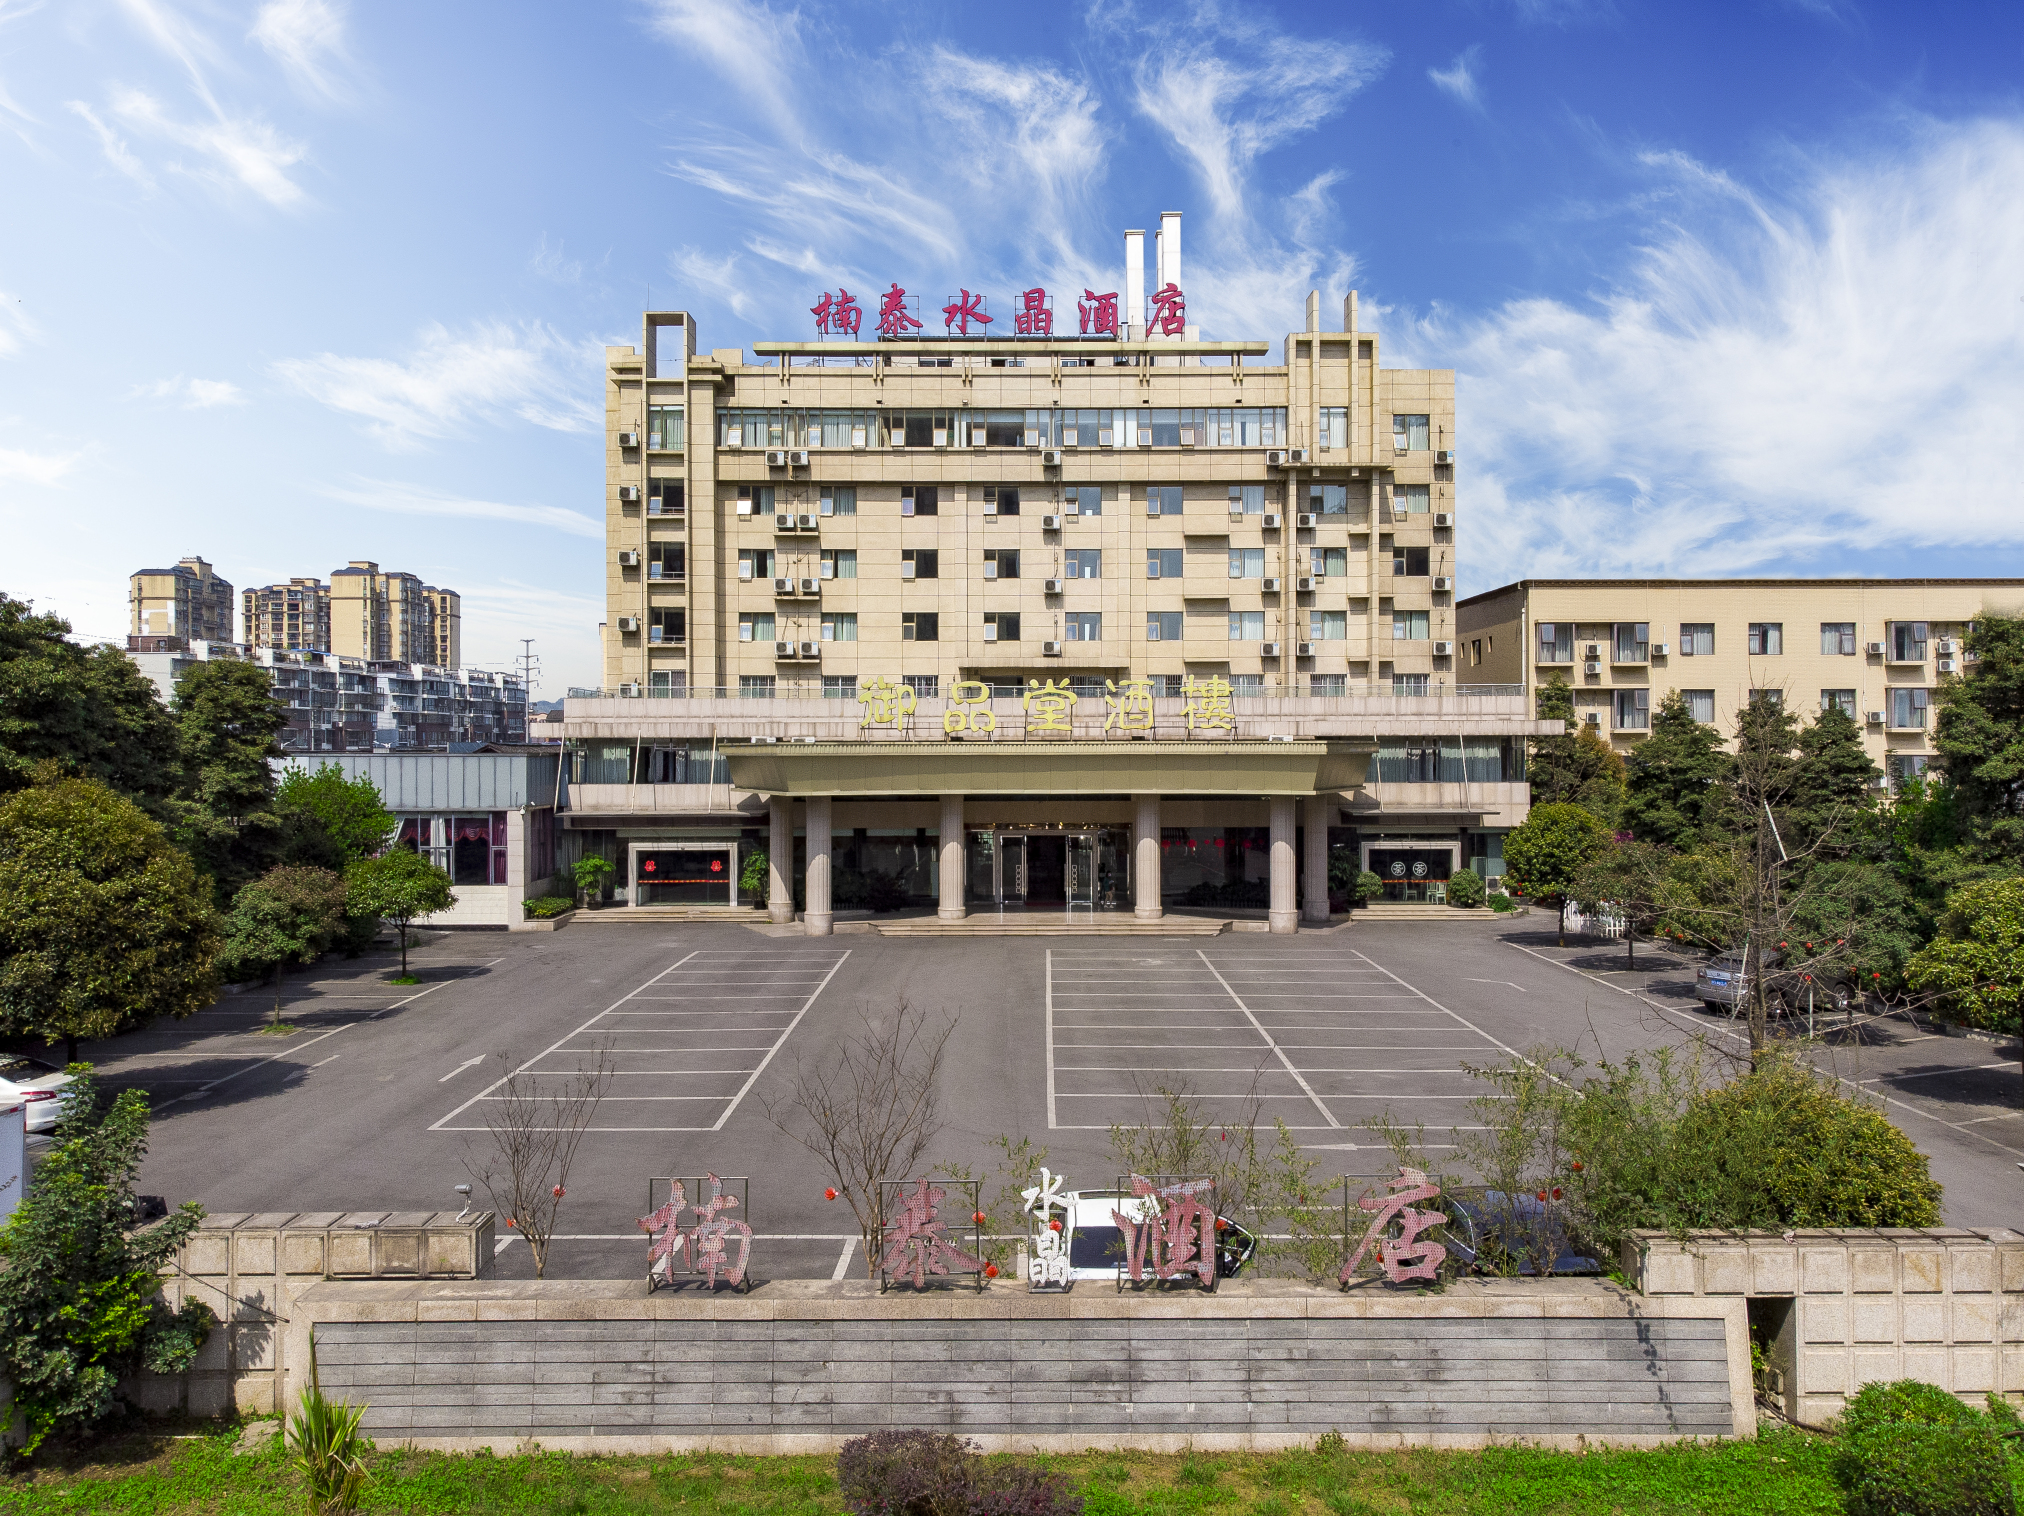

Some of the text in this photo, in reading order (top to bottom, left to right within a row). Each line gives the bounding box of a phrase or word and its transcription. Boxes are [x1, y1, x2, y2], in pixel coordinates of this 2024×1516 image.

[810, 282, 1186, 336] 楠泰水晶酒店
[858, 674, 1236, 733] 御品堂酒樓
